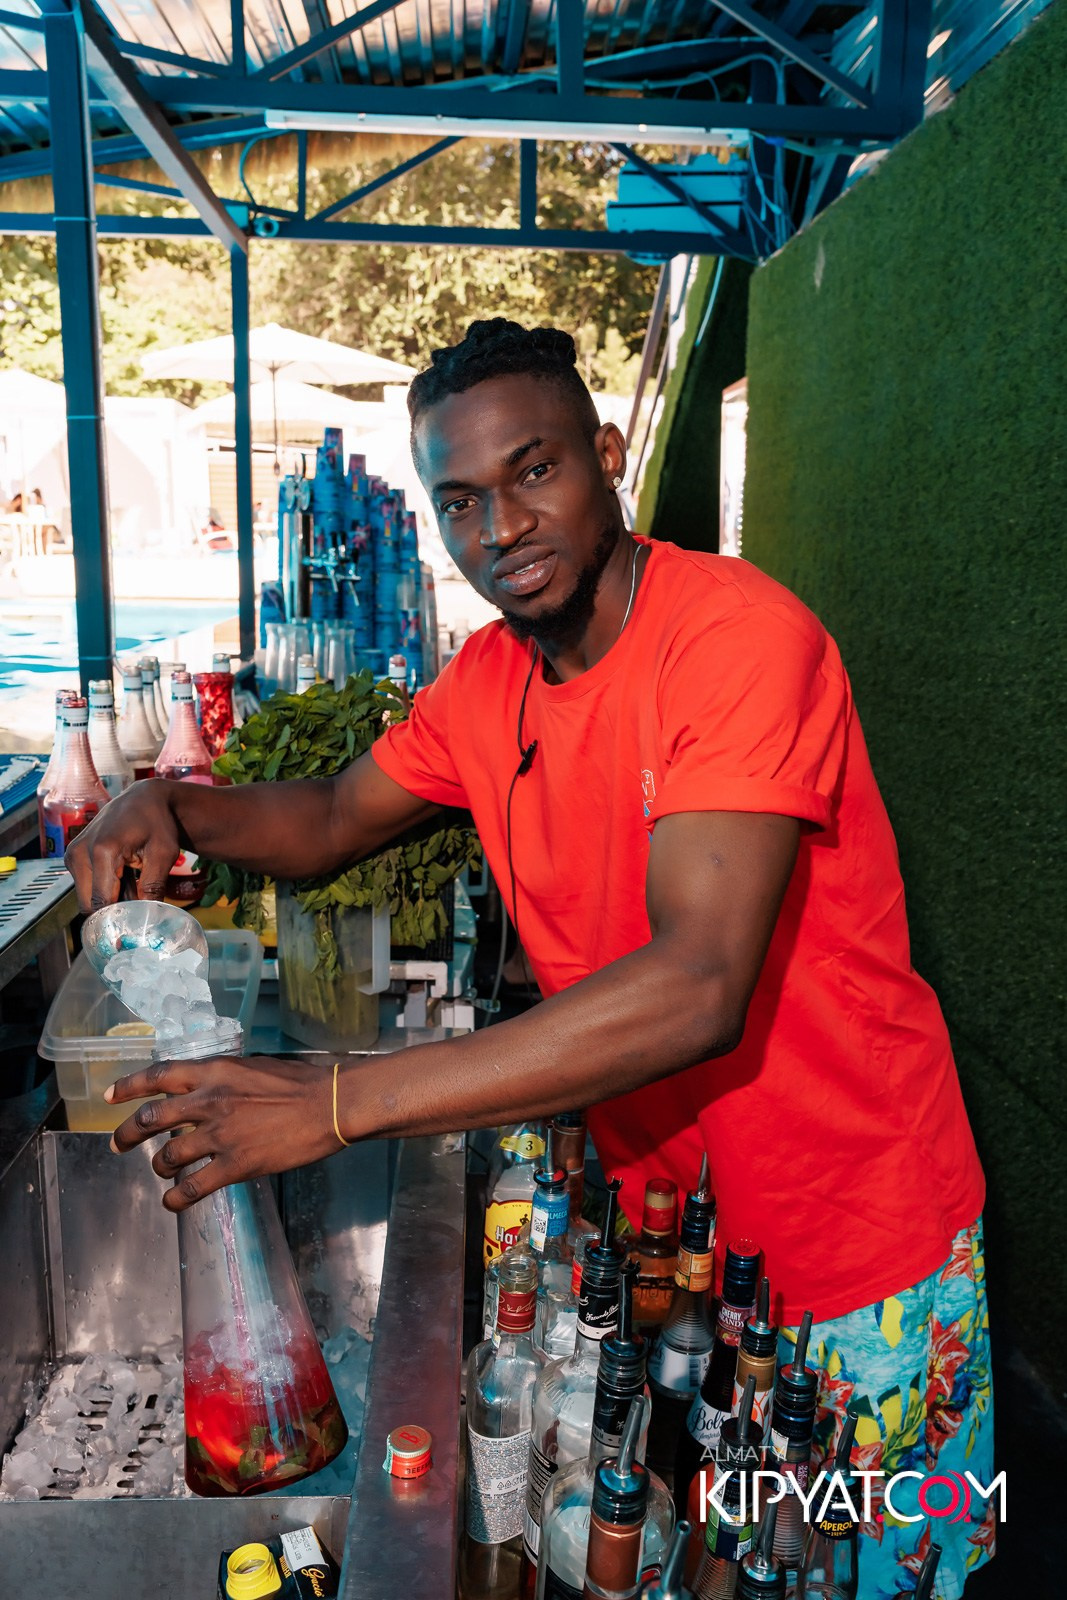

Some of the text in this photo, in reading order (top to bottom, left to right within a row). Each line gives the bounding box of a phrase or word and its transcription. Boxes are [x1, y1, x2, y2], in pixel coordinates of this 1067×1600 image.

[525, 1140, 533, 1152] 3
[548, 1211, 568, 1220] LMECA
[721, 1306, 742, 1321] CHERRY
[691, 1405, 726, 1433] Bols
[399, 1431, 421, 1445] B
[819, 1520, 853, 1531] APEROL
